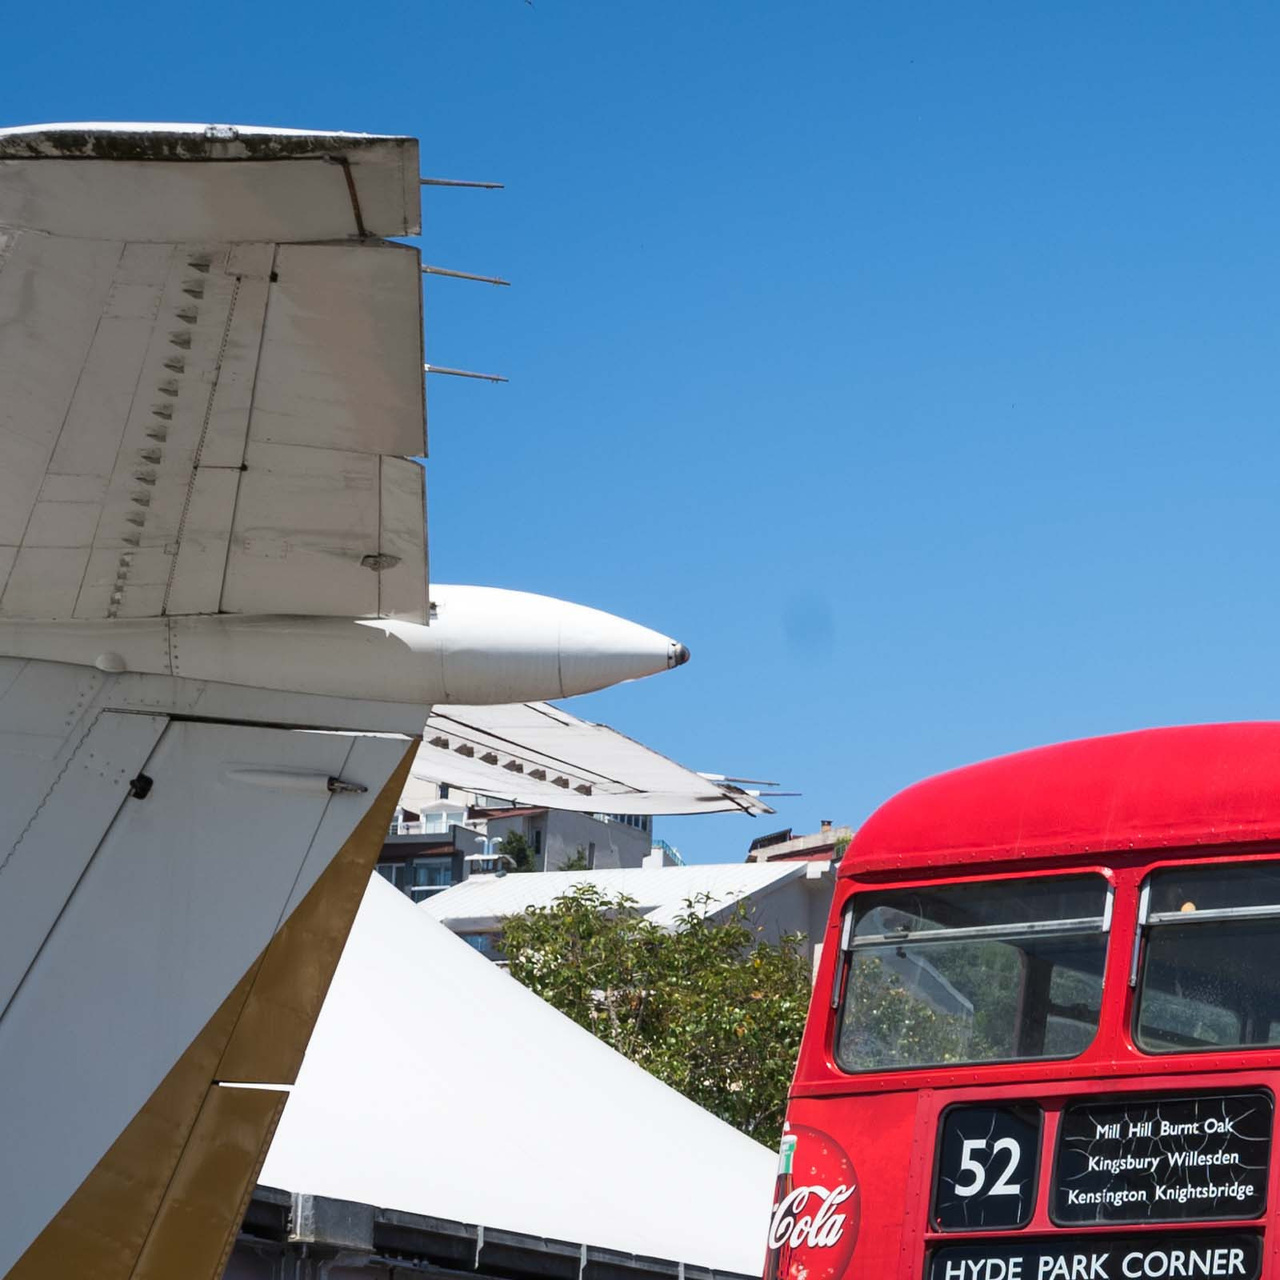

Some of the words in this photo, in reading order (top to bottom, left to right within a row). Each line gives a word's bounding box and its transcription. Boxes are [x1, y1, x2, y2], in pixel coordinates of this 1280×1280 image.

[1096, 1123, 1120, 1139] Mill
[1128, 1121, 1152, 1138] Hill
[1160, 1119, 1199, 1136] Burnt
[1204, 1117, 1234, 1134] Oak
[954, 1137, 1021, 1197] 52
[1088, 1154, 1160, 1173] Kingsbury
[1167, 1150, 1239, 1168] Willesden
[1068, 1186, 1147, 1206] Kensington
[1154, 1182, 1254, 1202] Knightsbridge
[1121, 1248, 1247, 1279] CORNER
